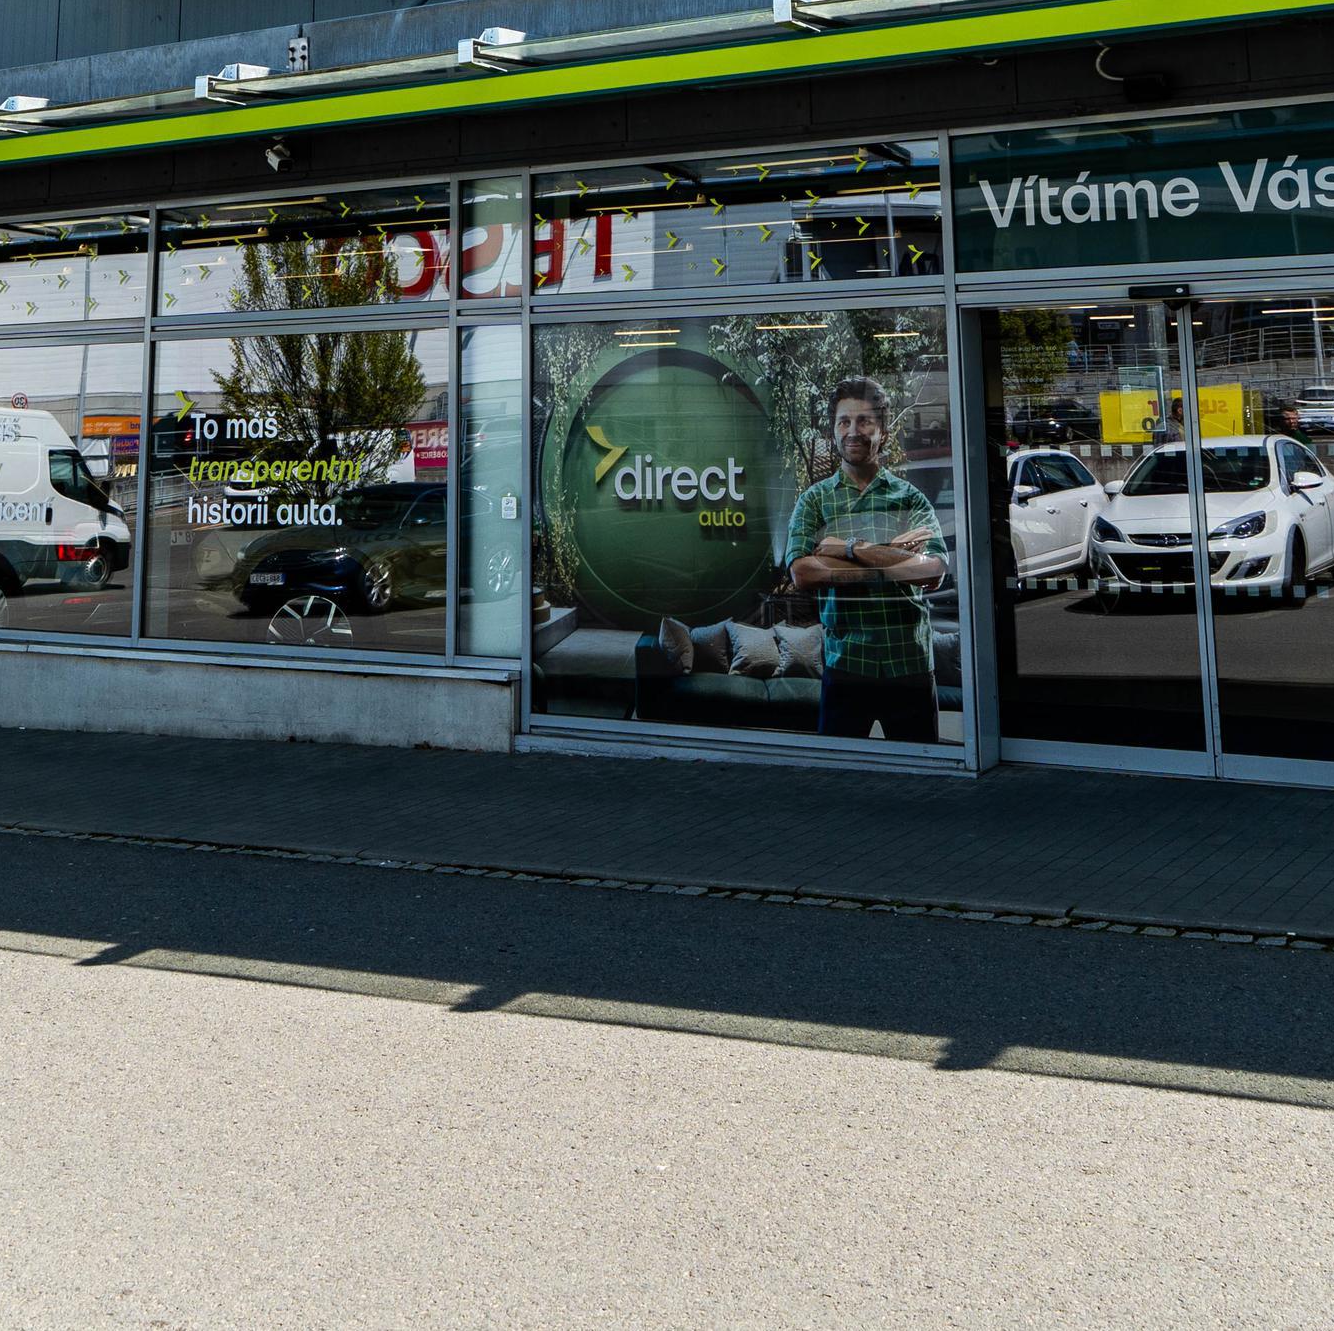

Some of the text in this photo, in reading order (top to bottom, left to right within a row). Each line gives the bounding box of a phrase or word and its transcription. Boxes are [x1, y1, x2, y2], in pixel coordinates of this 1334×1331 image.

[978, 171, 1200, 228] Vítáme
[191, 412, 278, 440] To máš
[188, 452, 366, 488] transparentní
[614, 454, 745, 501] direct
[188, 496, 343, 526] historii auta.
[699, 508, 746, 527] auto
